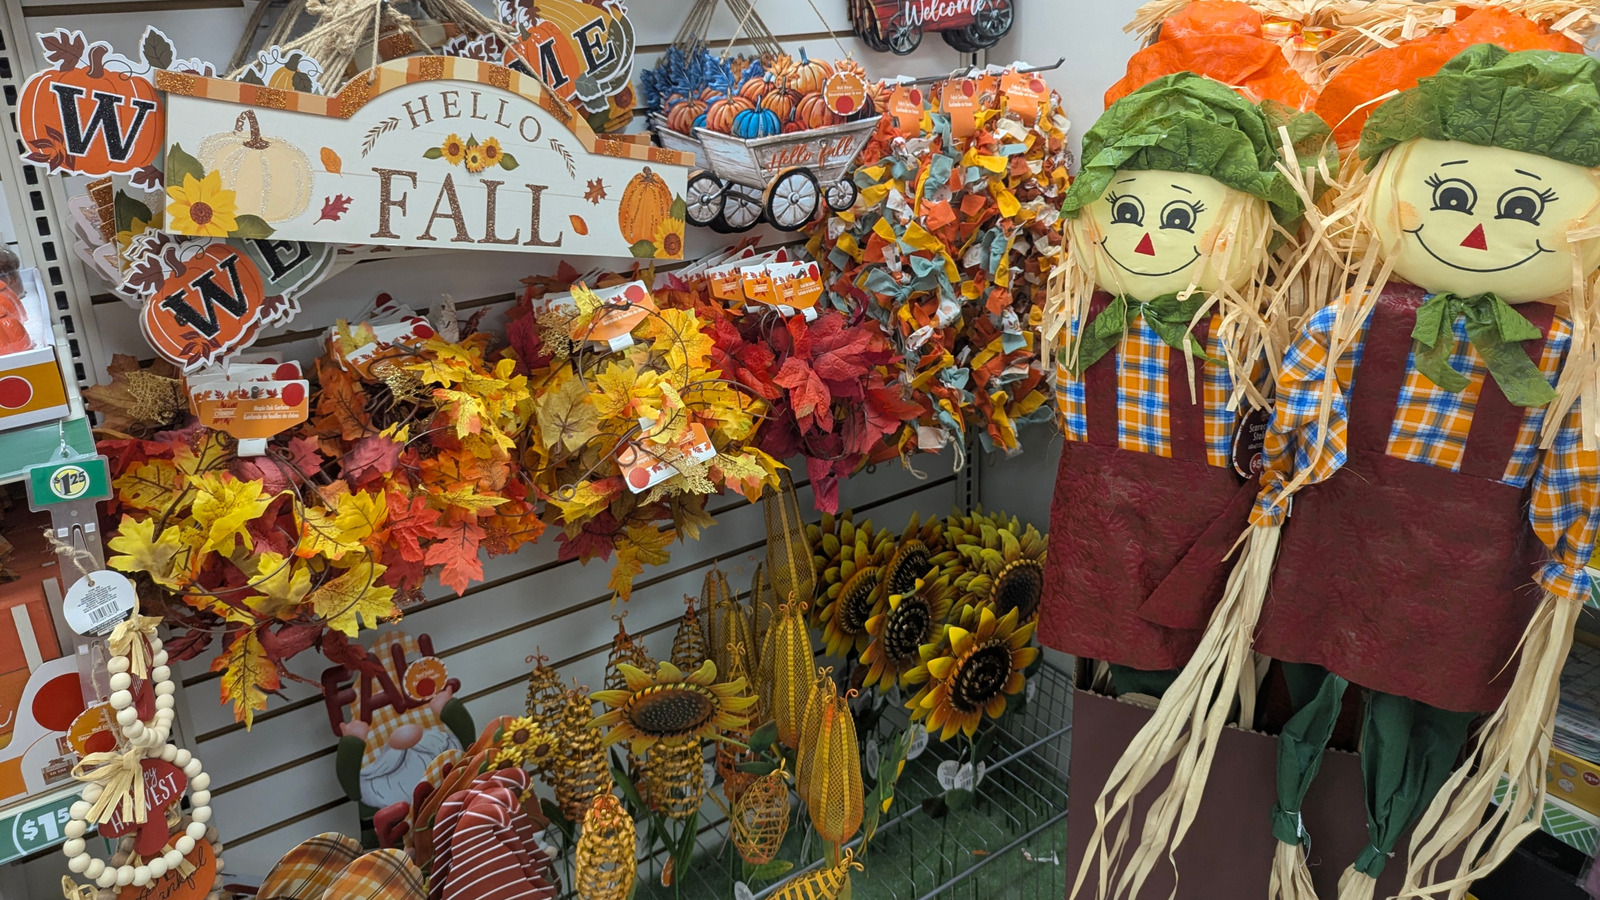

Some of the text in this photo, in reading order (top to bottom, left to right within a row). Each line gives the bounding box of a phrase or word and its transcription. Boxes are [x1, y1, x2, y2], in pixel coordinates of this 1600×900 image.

[905, 0, 986, 26] Welcome
[401, 90, 542, 142] HELLO
[765, 134, 853, 174] Hello fall
[370, 167, 563, 247] FALL
[110, 772, 178, 834] HVEST
